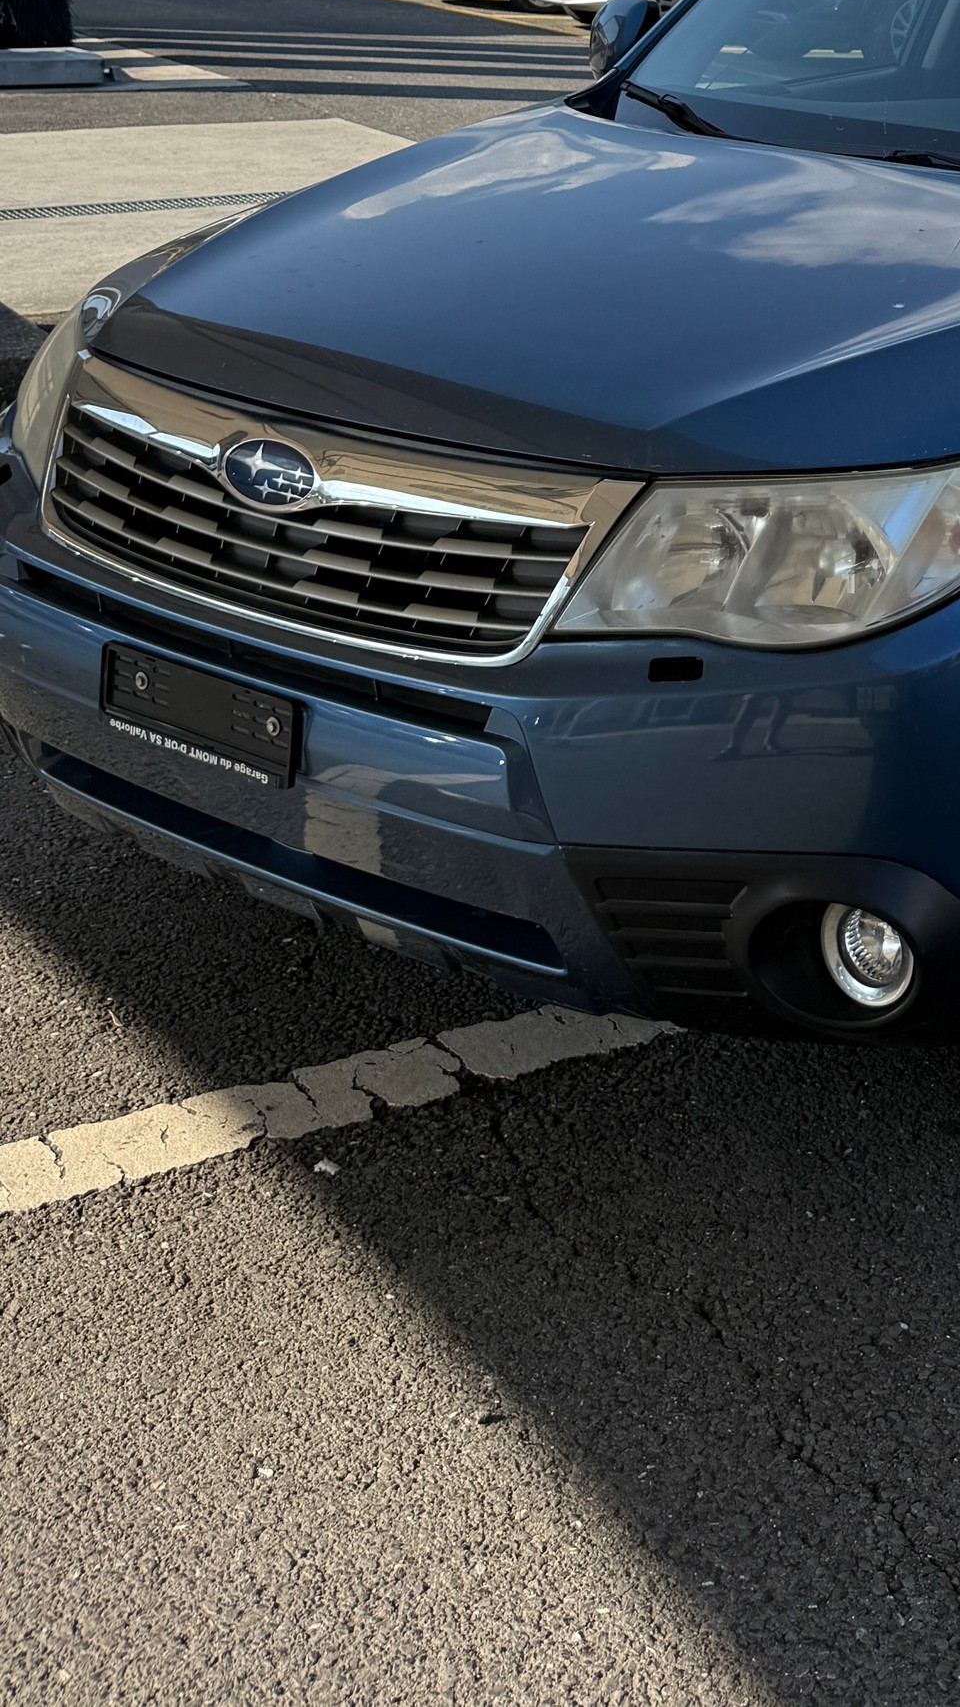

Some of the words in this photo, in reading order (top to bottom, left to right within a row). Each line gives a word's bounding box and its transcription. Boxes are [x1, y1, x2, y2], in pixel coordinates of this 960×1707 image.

[109, 718, 148, 740] Vallorbe
[149, 731, 163, 745] SA
[164, 737, 187, 754] D'OR
[189, 747, 218, 765] MONT
[220, 758, 232, 770] du
[234, 763, 269, 784] Garage
